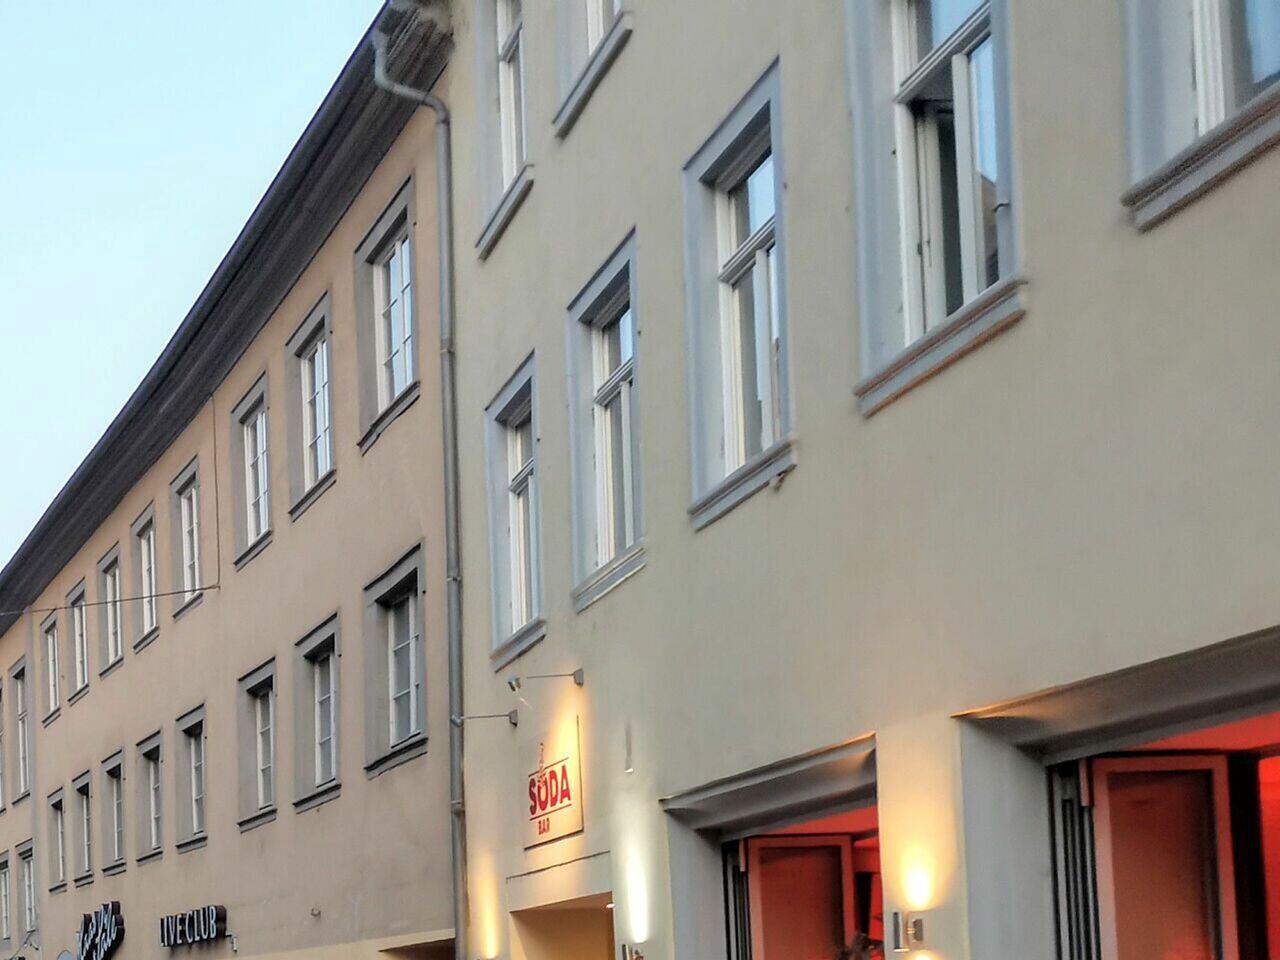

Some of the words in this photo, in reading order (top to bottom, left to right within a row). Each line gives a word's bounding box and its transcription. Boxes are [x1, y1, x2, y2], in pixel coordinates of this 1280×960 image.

[528, 764, 571, 816] SODA
[159, 914, 182, 947] LIVE
[186, 906, 217, 943] CLUB
